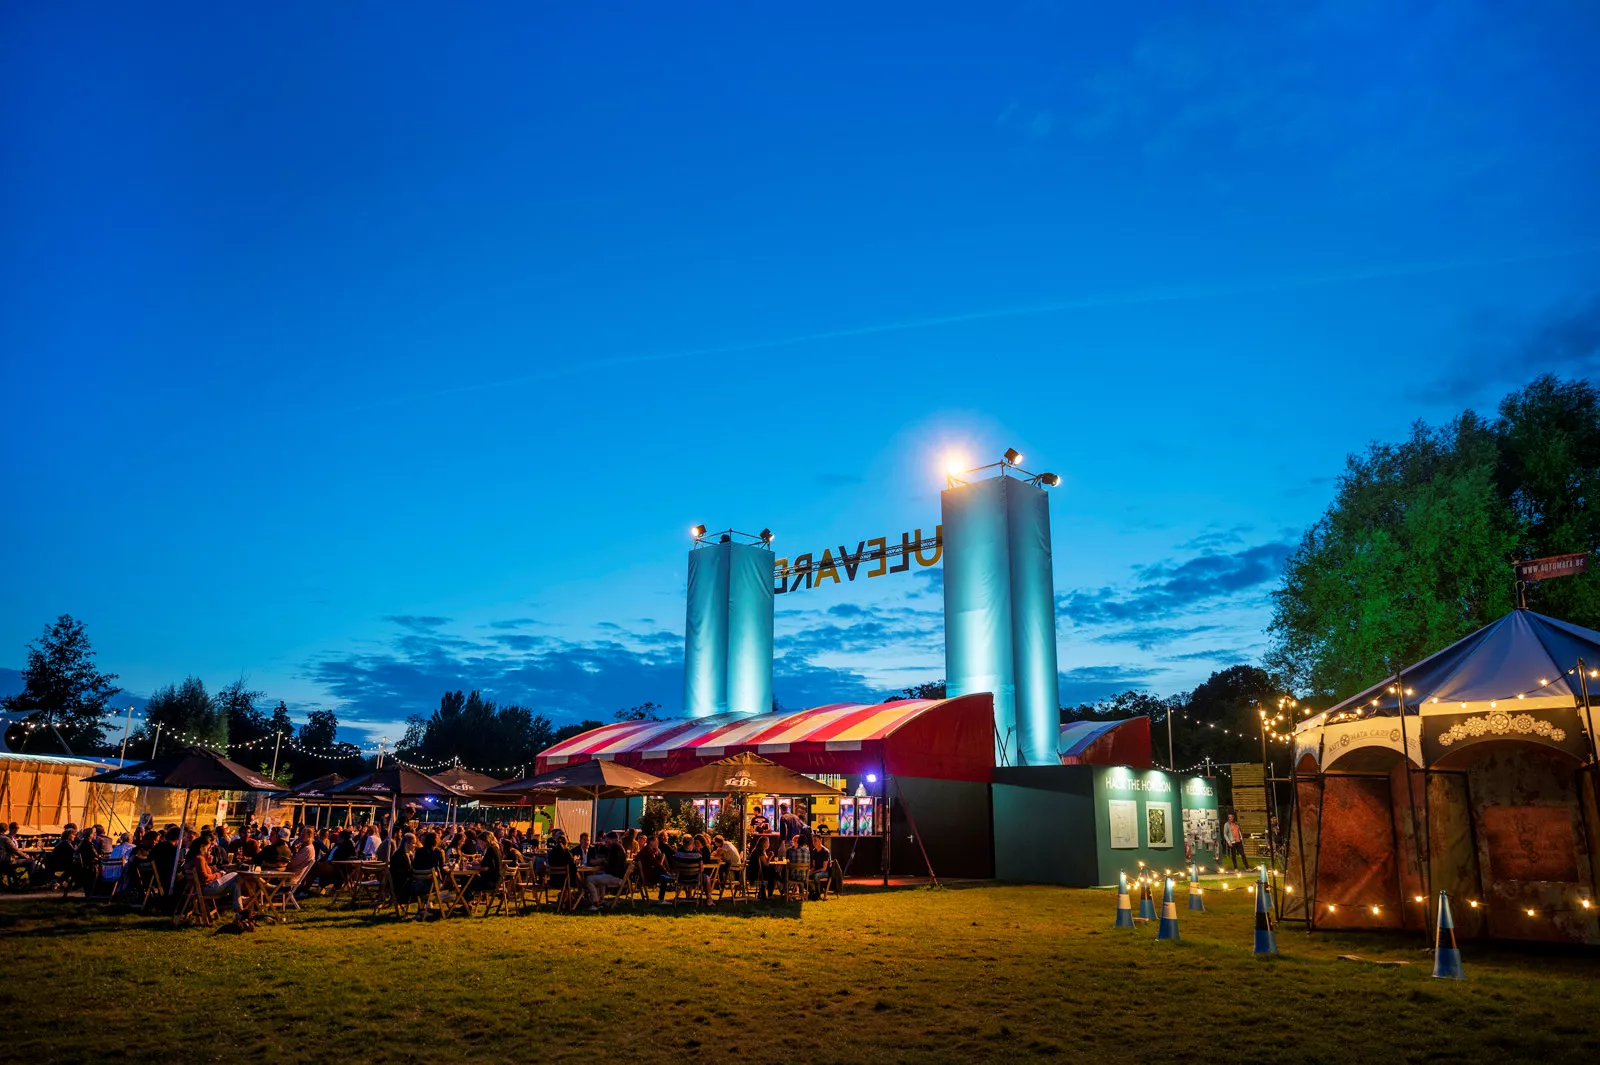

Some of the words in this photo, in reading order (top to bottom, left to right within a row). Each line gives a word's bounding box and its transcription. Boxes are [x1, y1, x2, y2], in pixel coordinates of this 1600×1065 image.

[1522, 559, 1584, 574] WWW.AUTOMATA.BE
[1128, 779, 1140, 790] THE
[1142, 780, 1171, 792] HOON
